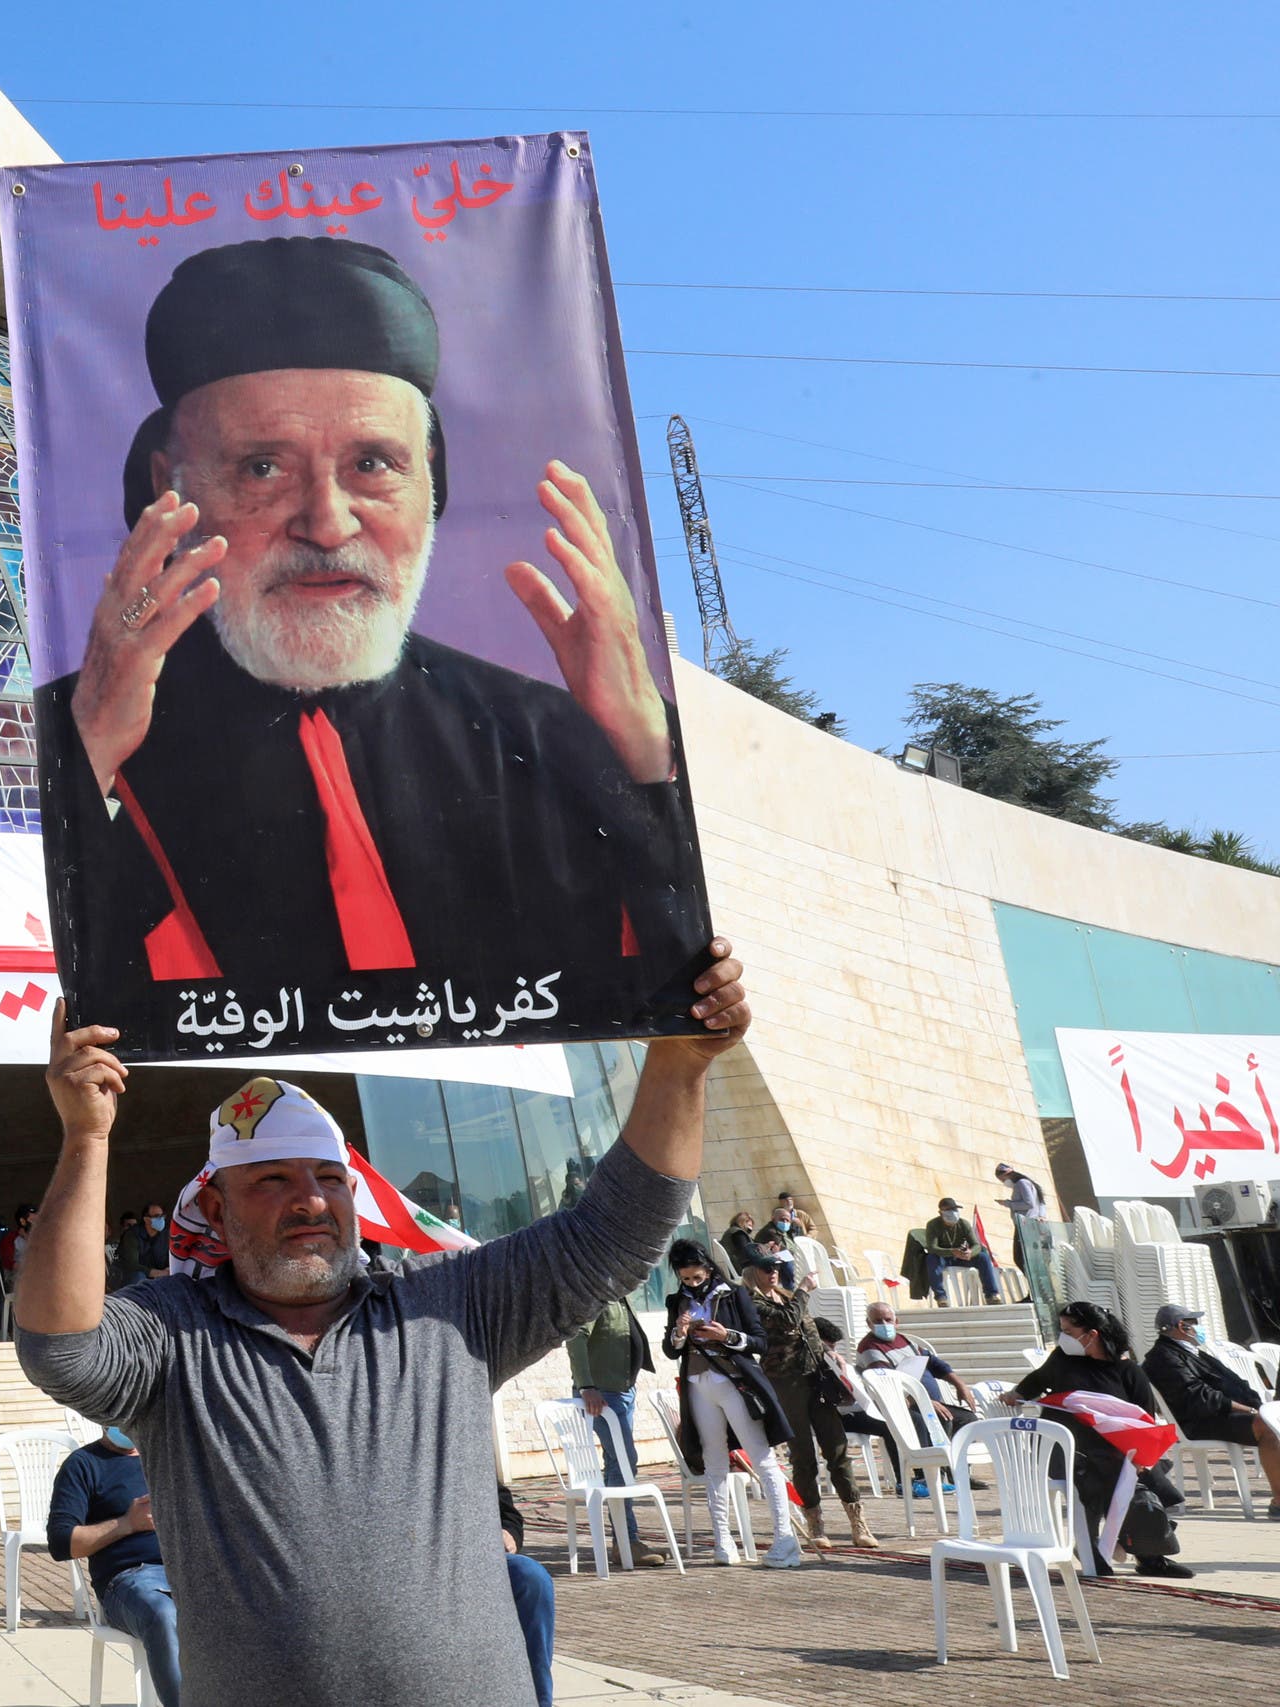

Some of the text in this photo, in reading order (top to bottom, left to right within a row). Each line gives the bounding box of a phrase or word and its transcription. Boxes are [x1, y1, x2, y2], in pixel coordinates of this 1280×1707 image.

[92, 177, 218, 248] علينا
[244, 169, 383, 237] عينك
[1015, 1419, 1033, 1430] C6
